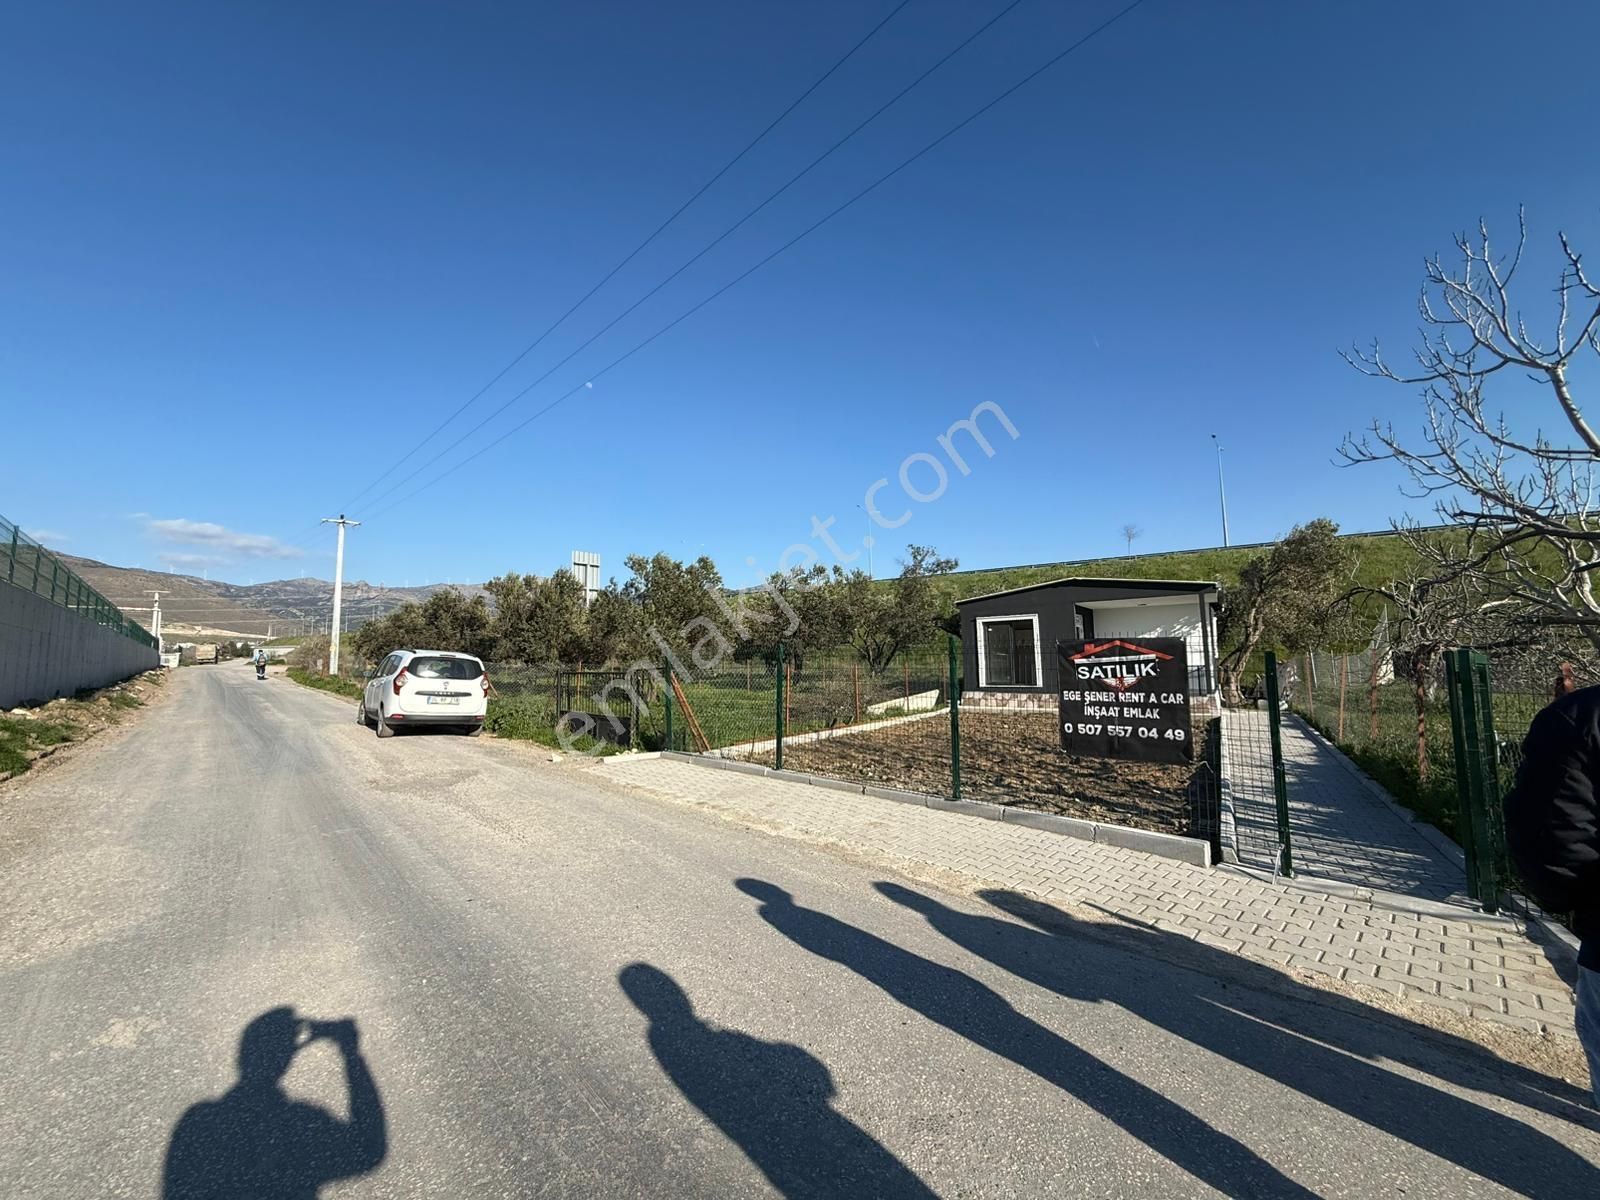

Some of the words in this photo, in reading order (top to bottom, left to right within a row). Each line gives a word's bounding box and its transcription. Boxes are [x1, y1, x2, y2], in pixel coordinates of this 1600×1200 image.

[1077, 662, 1157, 680] SATILIK
[1063, 690, 1081, 701] EGE
[1084, 691, 1116, 705] ŞENER
[1118, 692, 1145, 703] RENT
[1149, 693, 1158, 703] A
[1160, 693, 1184, 704] CAR
[1084, 704, 1120, 720] İNŞAAT
[1123, 707, 1160, 719] EMLAK
[1064, 722, 1073, 733] 0
[1077, 723, 1102, 735] 507
[1107, 725, 1133, 737] 557
[1138, 727, 1159, 739] 04
[1164, 728, 1185, 741] 49
